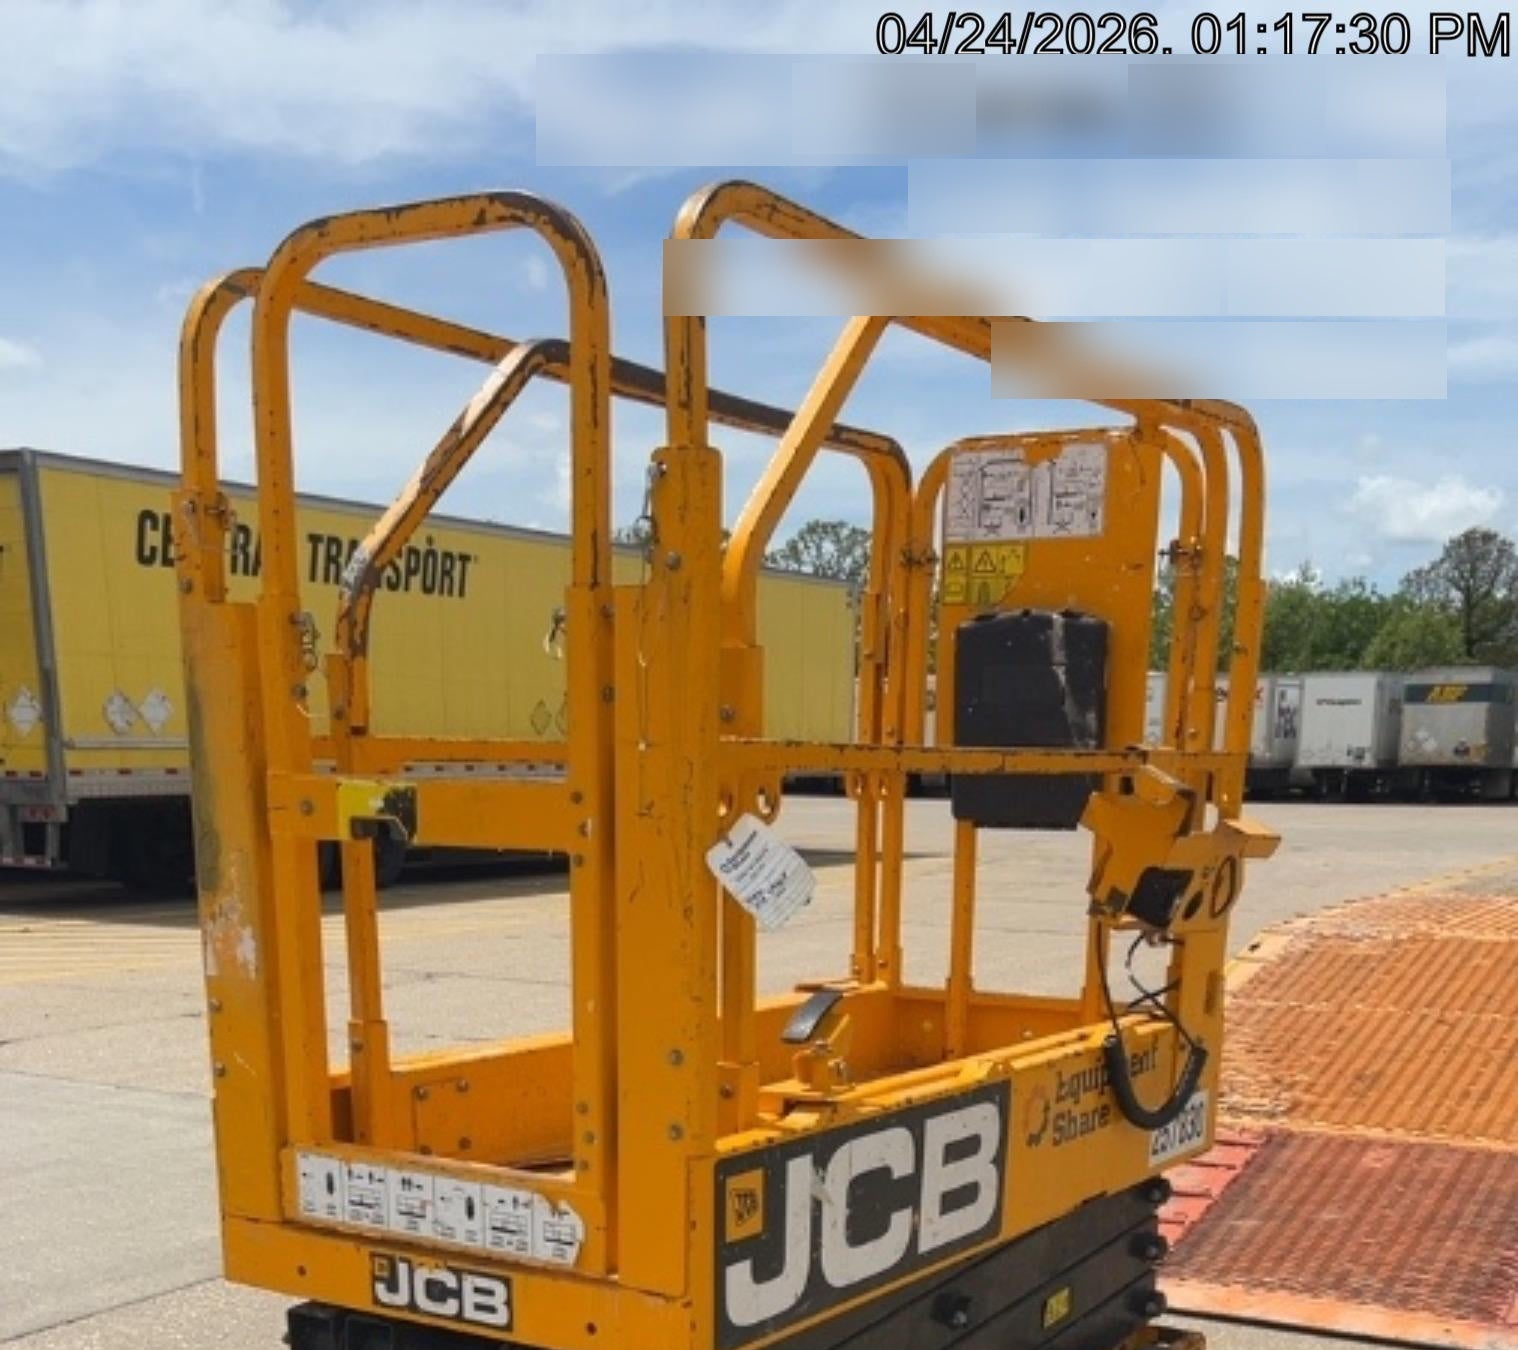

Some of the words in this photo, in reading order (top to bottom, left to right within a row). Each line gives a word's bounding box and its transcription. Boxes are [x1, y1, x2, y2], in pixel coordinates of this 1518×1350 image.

[1055, 1036, 1159, 1105] Equipent
[1052, 1102, 1111, 1147] Share
[724, 1101, 1001, 1328] JCB
[374, 1260, 511, 1327] JCB
